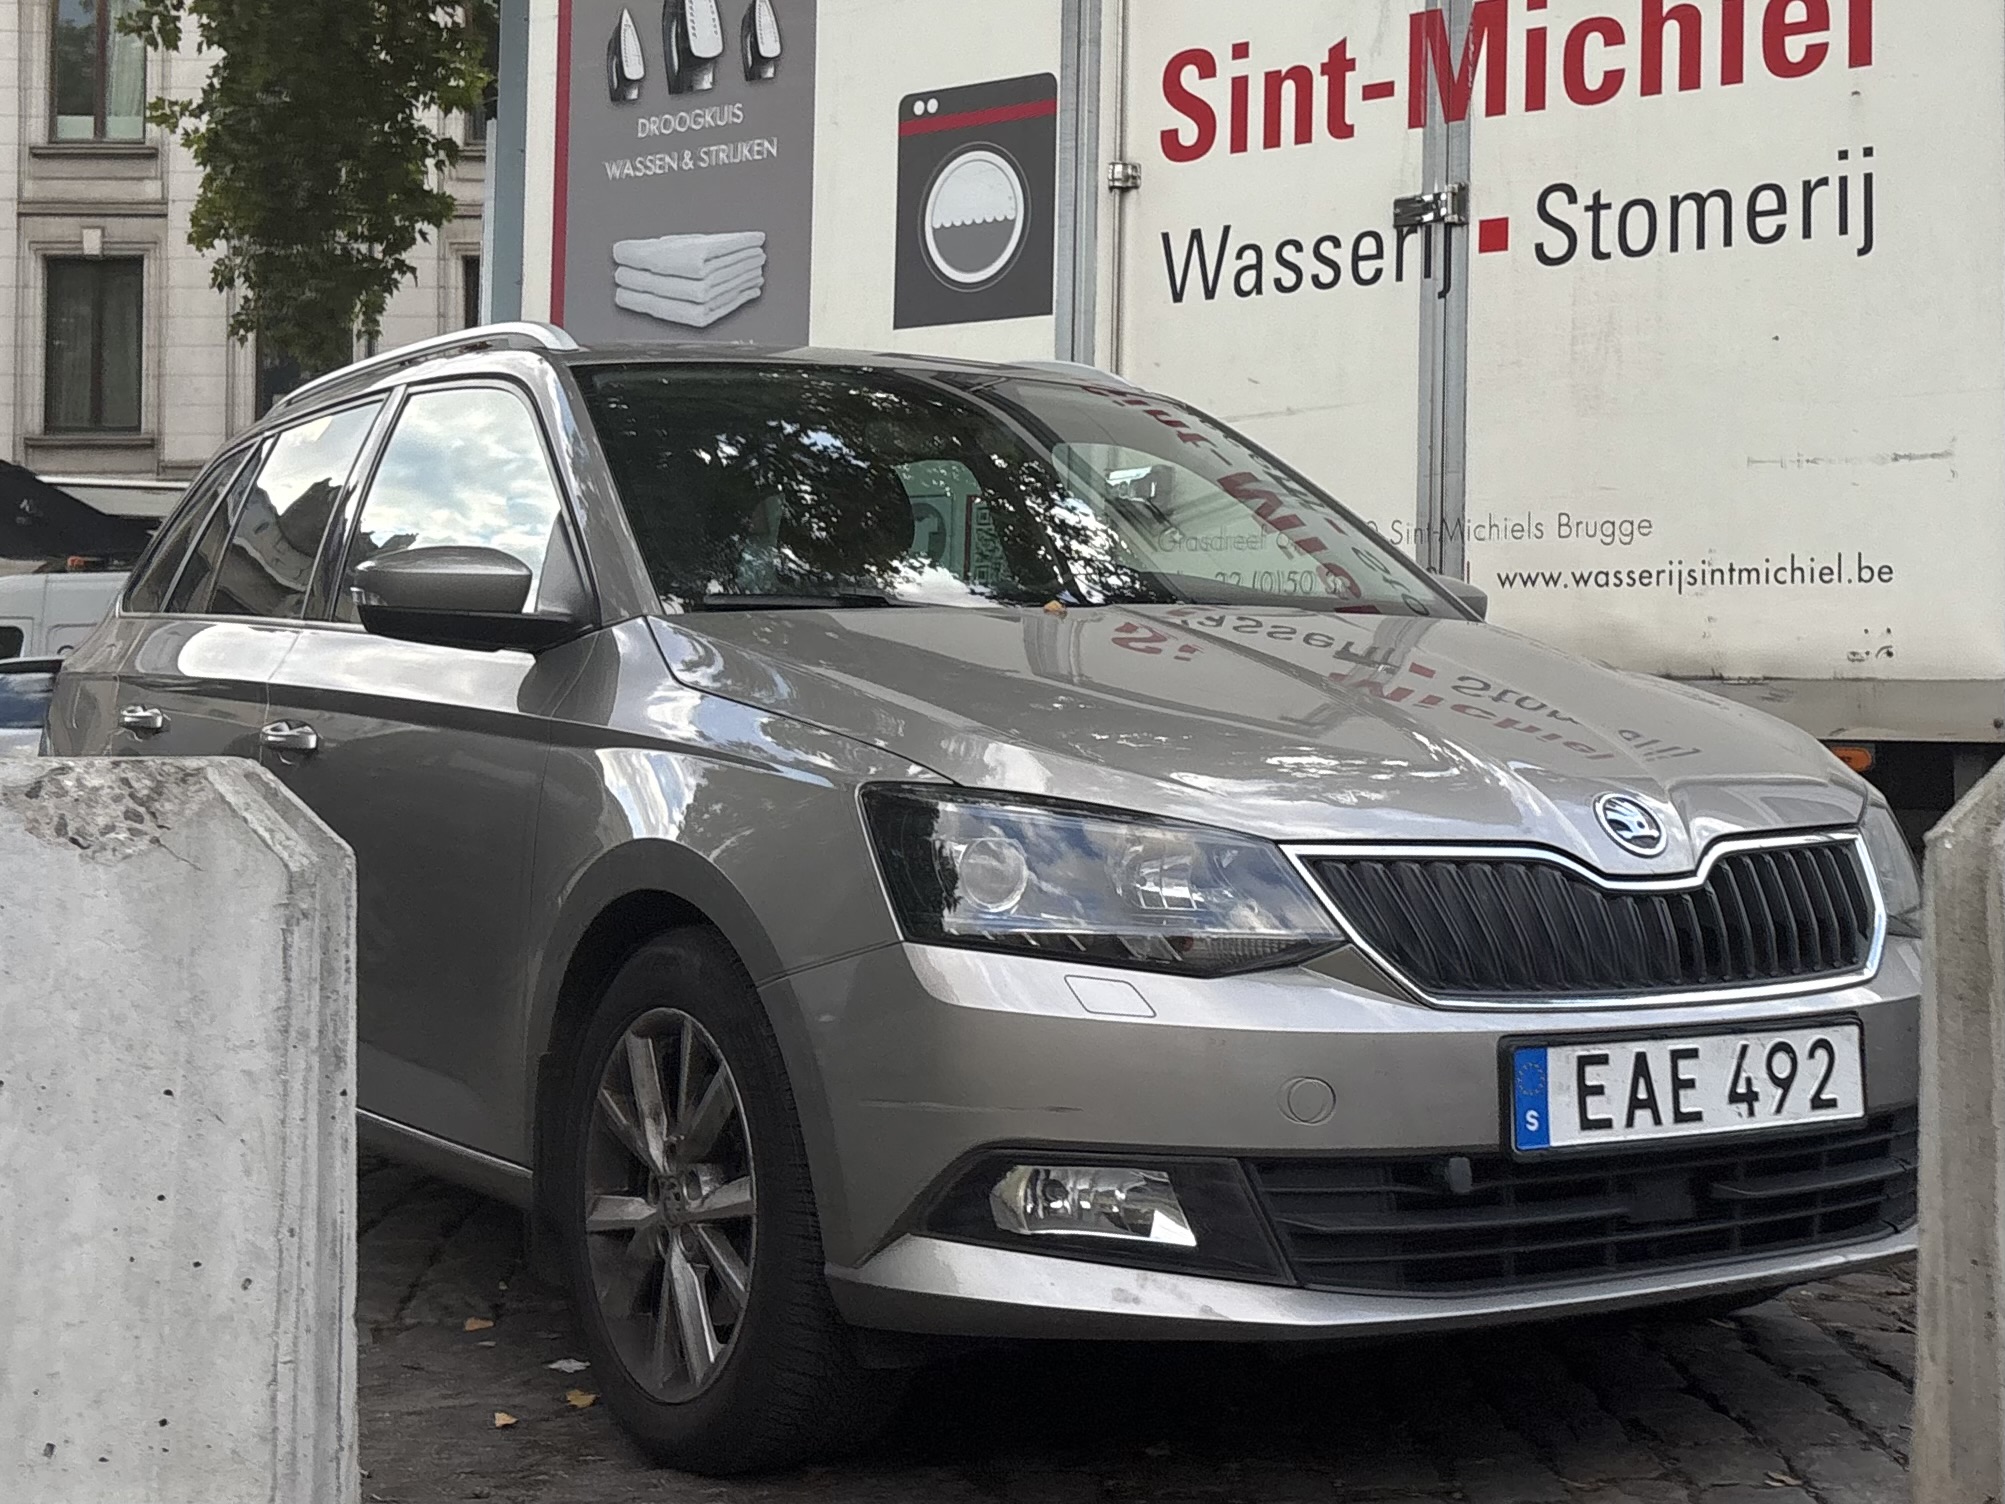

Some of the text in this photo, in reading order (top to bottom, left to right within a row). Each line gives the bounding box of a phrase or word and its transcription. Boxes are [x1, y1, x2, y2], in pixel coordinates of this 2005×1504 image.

[1159, 0, 1874, 163] Sint-Michiel
[637, 103, 744, 138] DROOGKUIS
[603, 137, 778, 181] WASSEN & STRIJKEN
[1161, 146, 1875, 304] Wasserij Stomerij
[1390, 511, 1545, 546] Sint-Michiels
[1557, 511, 1654, 546] Brugge
[1496, 552, 1894, 595] www.wasserijsintmichiel.be
[1576, 1037, 1838, 1131] EAE 492
[1525, 1110, 1540, 1132] S
